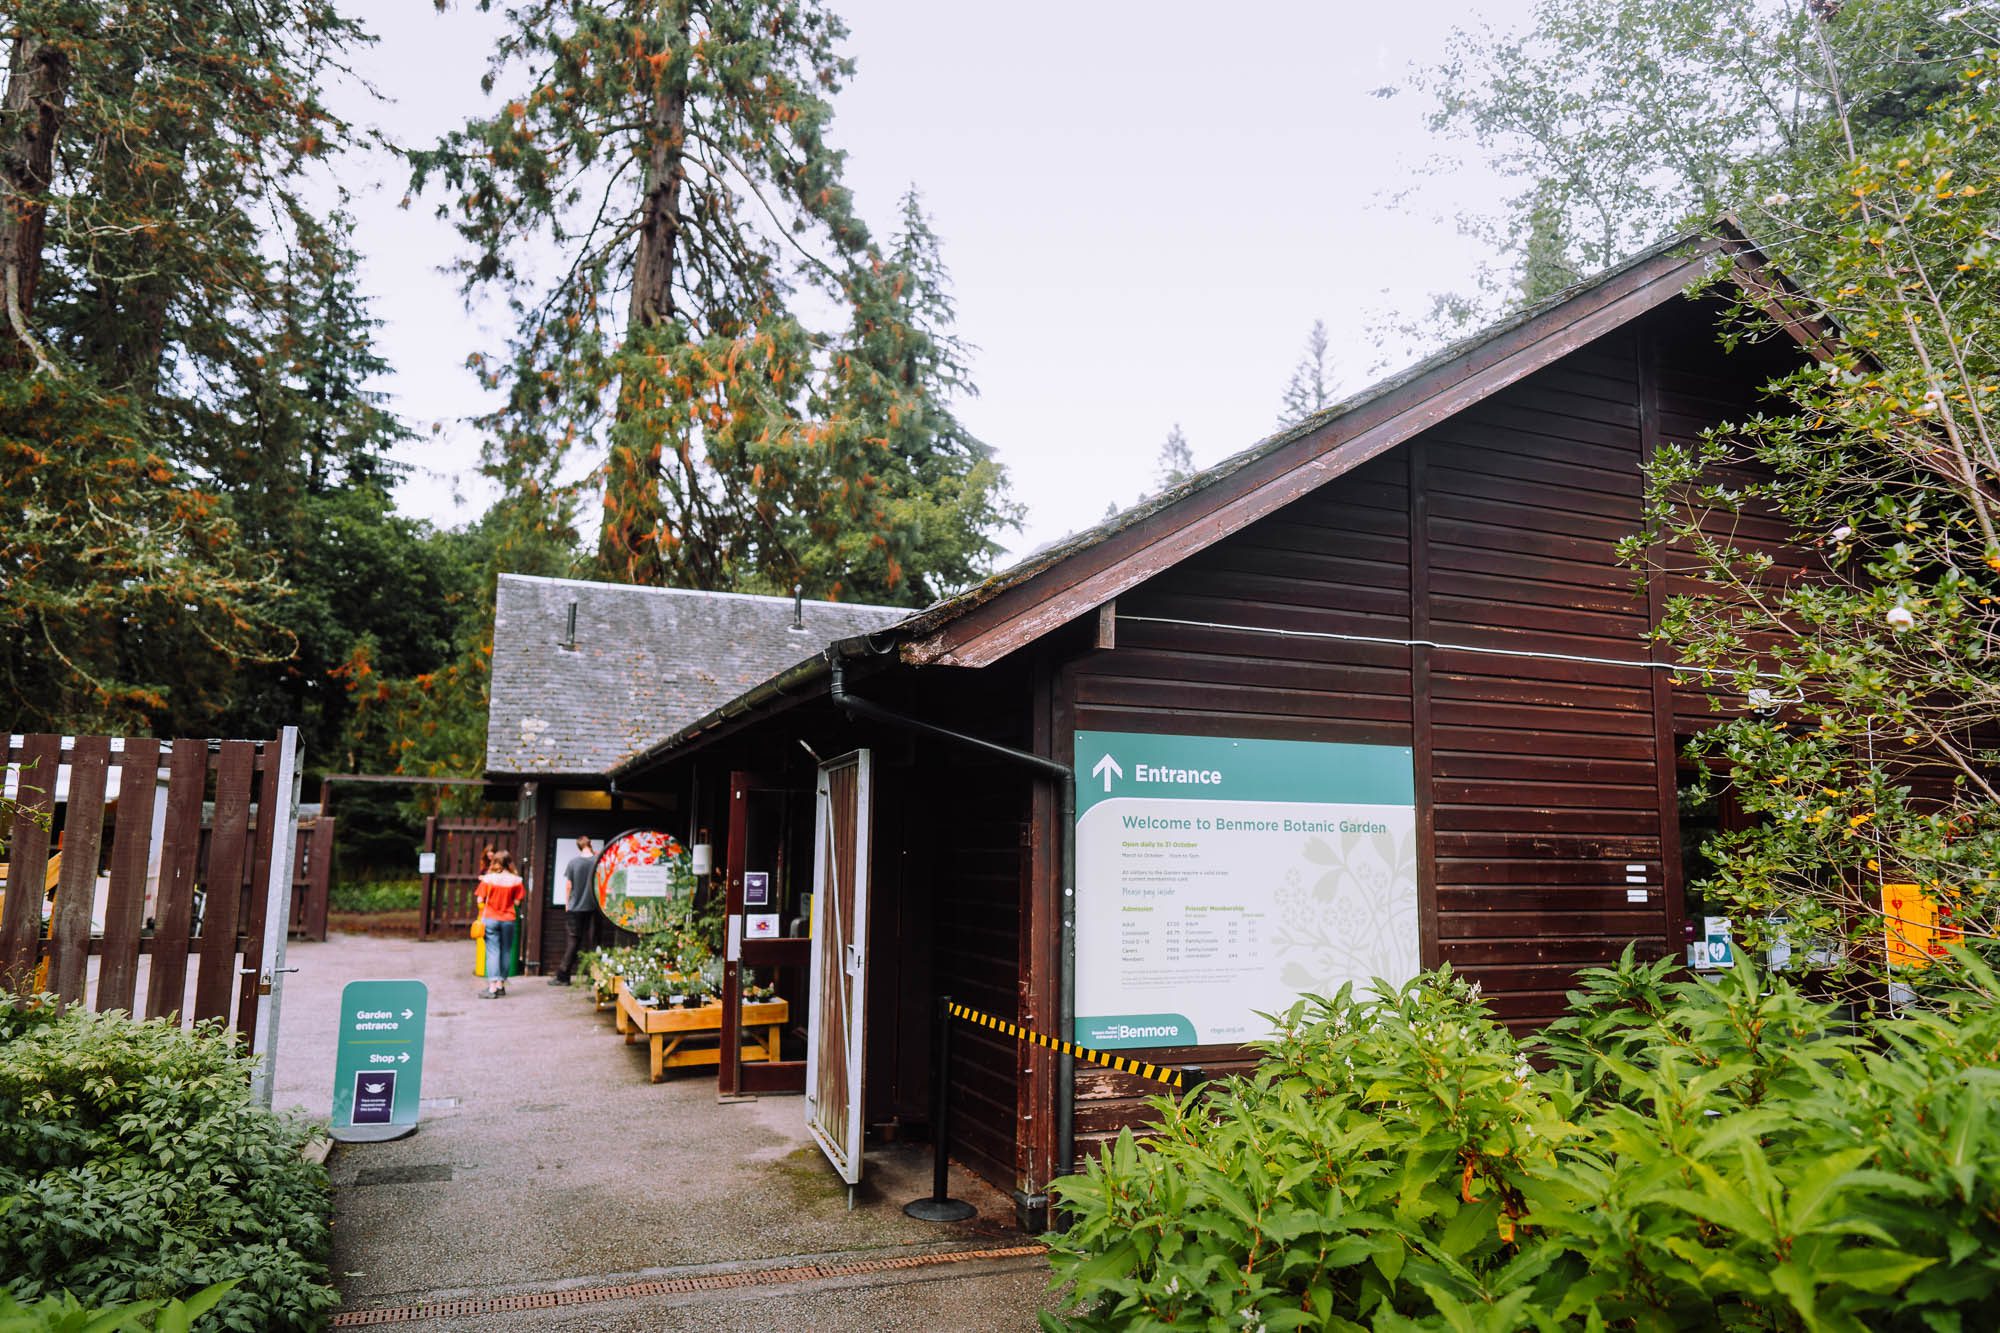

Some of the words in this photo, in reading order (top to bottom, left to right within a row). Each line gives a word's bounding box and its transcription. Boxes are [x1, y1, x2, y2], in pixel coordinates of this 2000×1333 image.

[1135, 764, 1222, 785] Entrance
[1122, 815, 1192, 830] Welcome
[1197, 817, 1211, 830] to
[1216, 818, 1279, 832] Benmore
[1283, 819, 1335, 833] Botanic
[1339, 820, 1387, 834] Garden
[357, 1010, 392, 1020] Garden
[356, 1022, 399, 1031] entrance
[1120, 1024, 1179, 1039] Benmore
[369, 1053, 395, 1064] Shop
